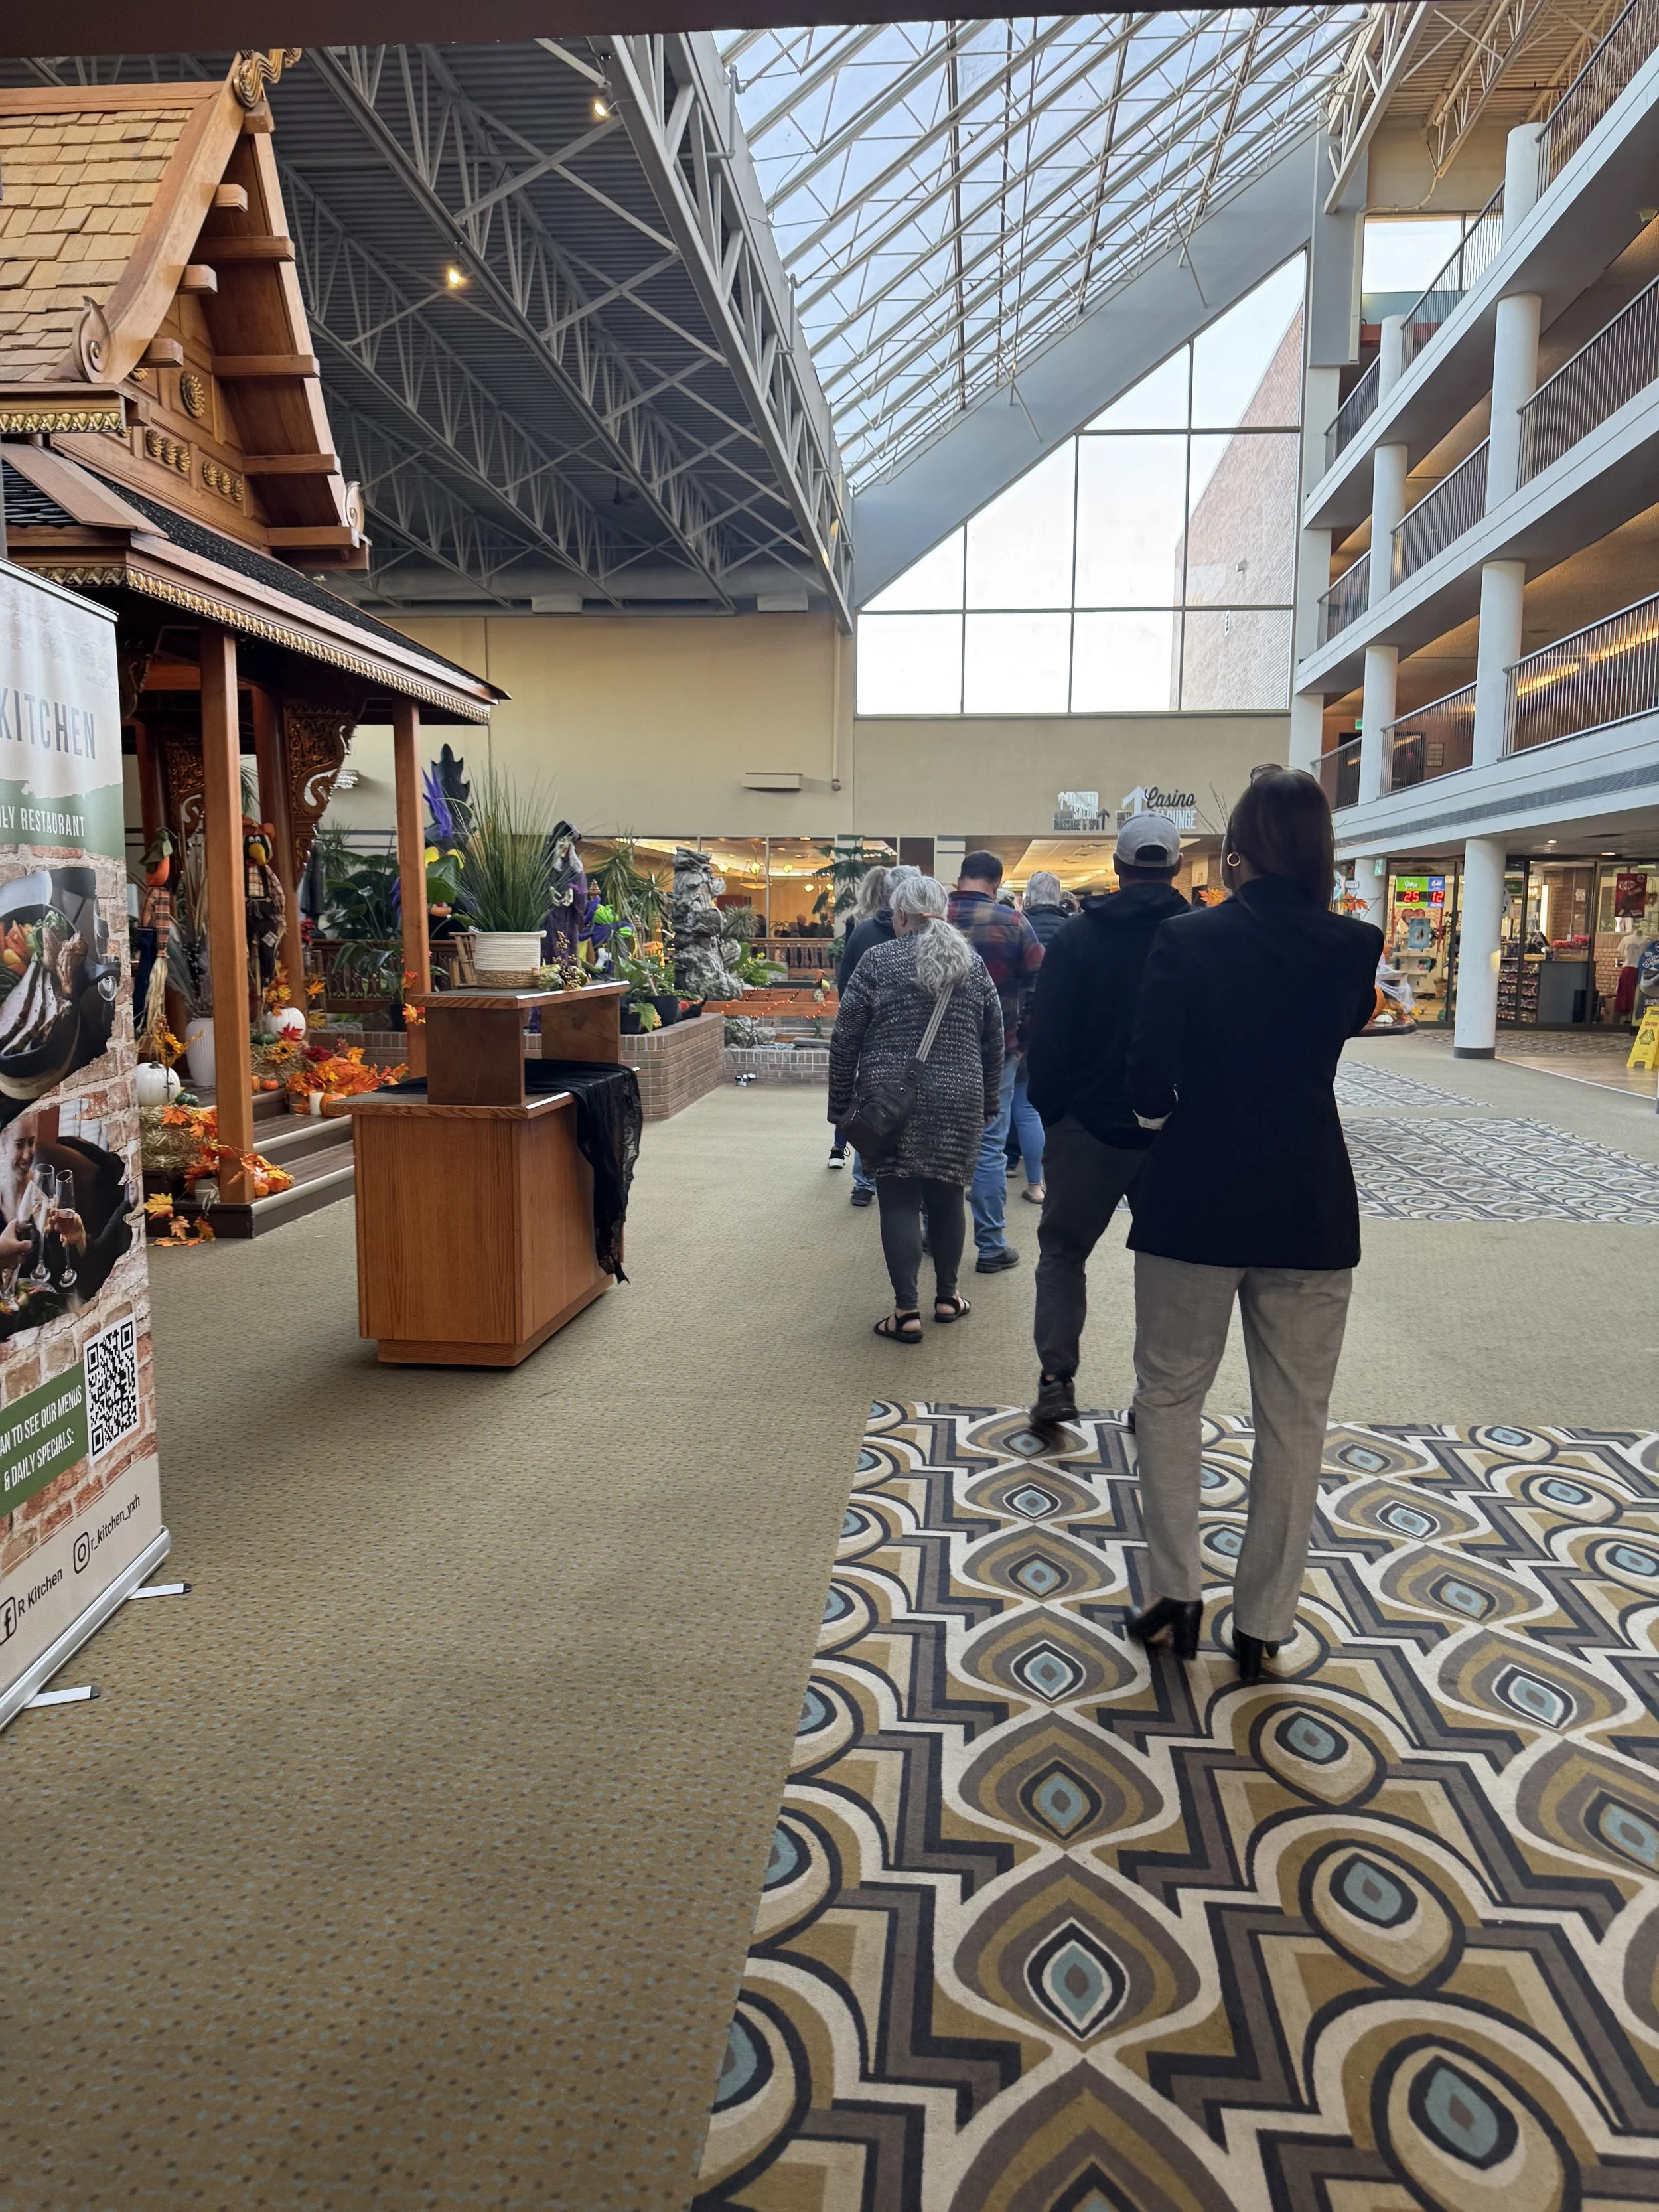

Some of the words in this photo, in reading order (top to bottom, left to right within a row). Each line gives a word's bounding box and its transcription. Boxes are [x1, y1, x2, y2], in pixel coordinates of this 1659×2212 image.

[0, 688, 96, 759] KITCHEN
[21, 808, 84, 837] RESTAURANT
[1145, 786, 1196, 808] Casino
[1404, 890, 1420, 903] 25
[1432, 890, 1445, 903] 12
[11, 1424, 23, 1447] TO
[24, 1412, 40, 1439] SEE
[41, 1402, 57, 1428] OUR
[57, 1384, 82, 1418] MENUS
[4, 1470, 11, 1492] &
[11, 1452, 35, 1487] DAILY
[36, 1428, 74, 1468] SPECIALS:
[90, 1495, 141, 1550] r_kitchen_yxh
[18, 1599, 25, 1617] R
[28, 1568, 62, 1609] Kitchen
